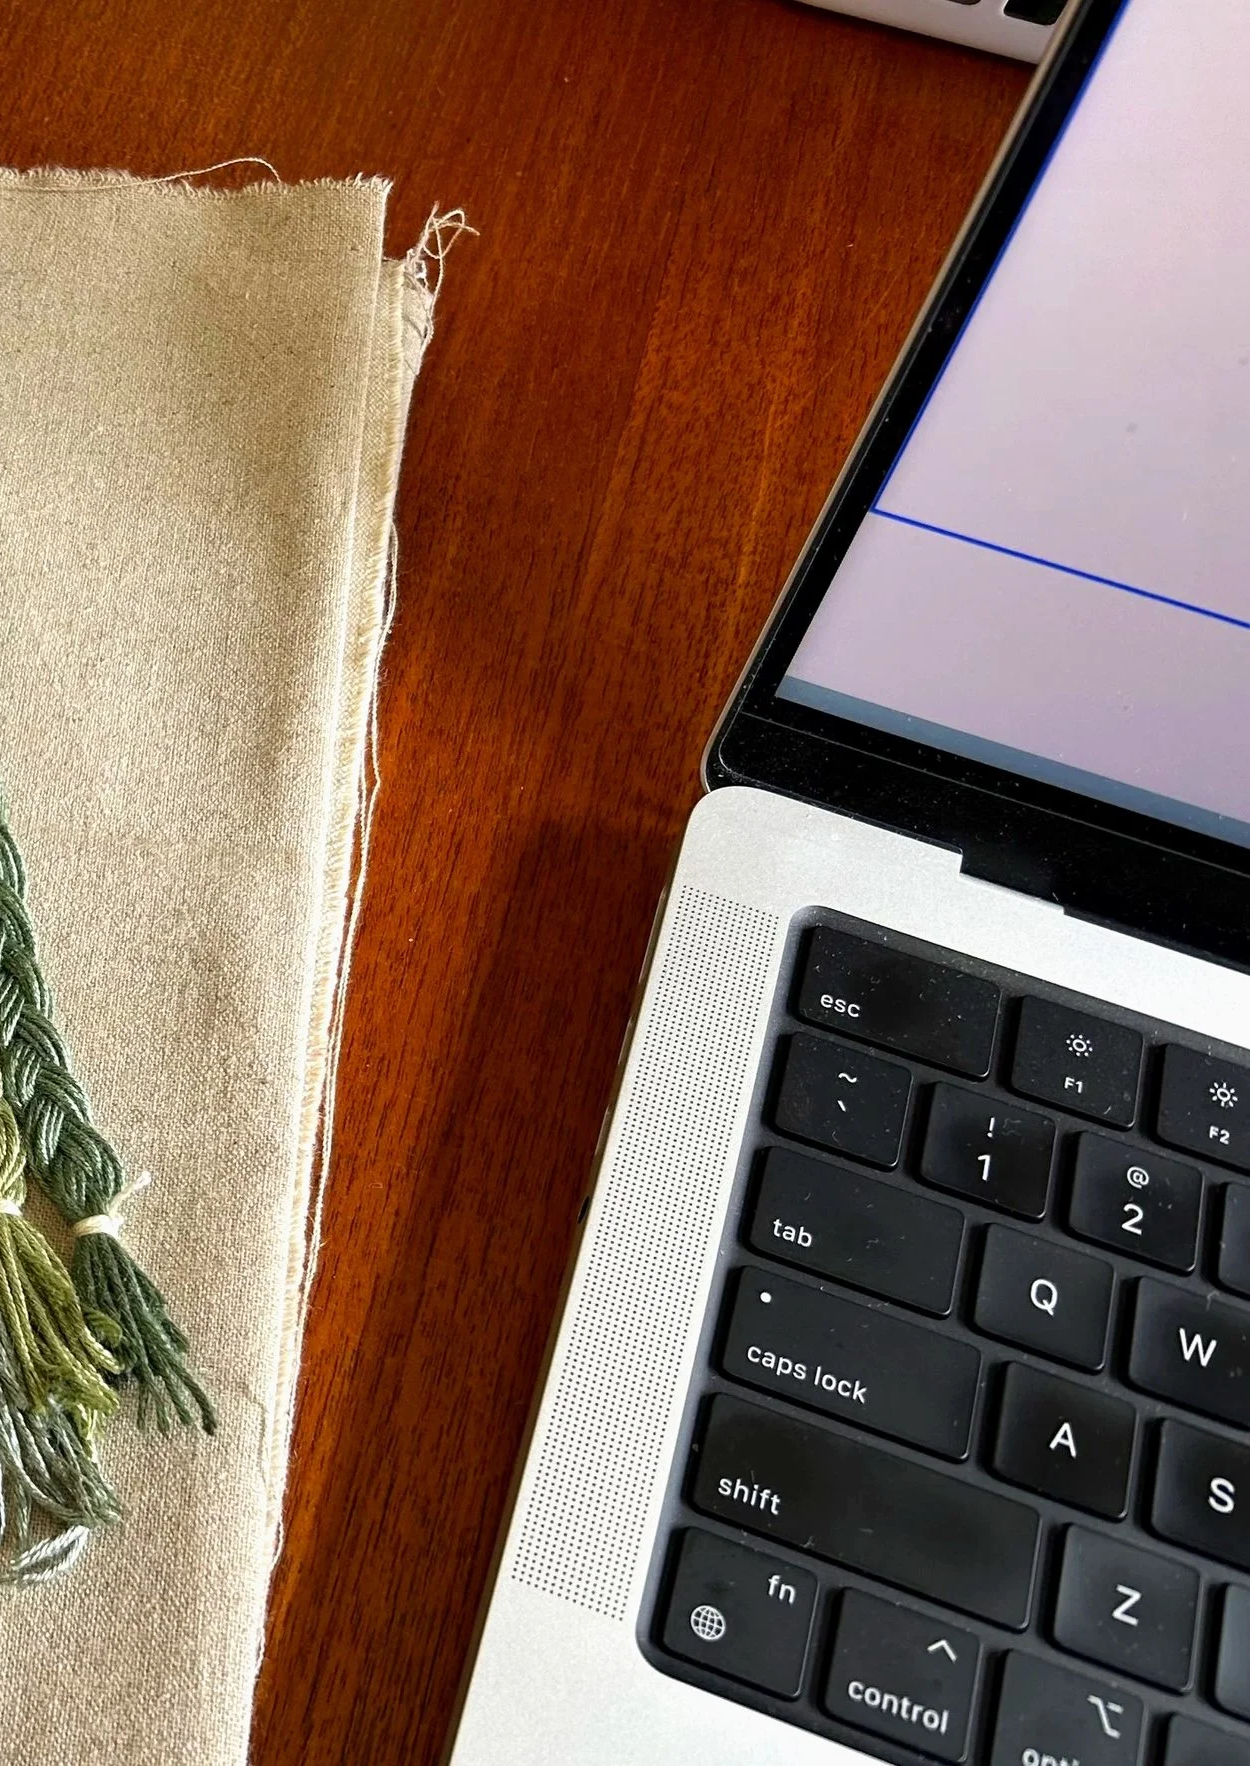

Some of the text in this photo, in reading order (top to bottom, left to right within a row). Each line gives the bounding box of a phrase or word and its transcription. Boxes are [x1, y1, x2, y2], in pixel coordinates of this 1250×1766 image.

[820, 994, 861, 1019] esc
[1064, 1076, 1084, 1095] F1
[986, 1116, 996, 1139] !
[1208, 1125, 1230, 1145] F2
[977, 1154, 992, 1182] 1
[1125, 1166, 1150, 1189] @
[772, 1218, 813, 1249] tab
[1121, 1203, 1145, 1236] 2
[1029, 1277, 1059, 1317] Q
[1178, 1327, 1218, 1368] W
[746, 1344, 868, 1404] caps lock
[1049, 1421, 1078, 1459] A
[717, 1476, 782, 1516] shift
[1207, 1476, 1236, 1514] S
[768, 1574, 797, 1605] fn
[1111, 1583, 1143, 1627] Z
[847, 1680, 950, 1734] control
